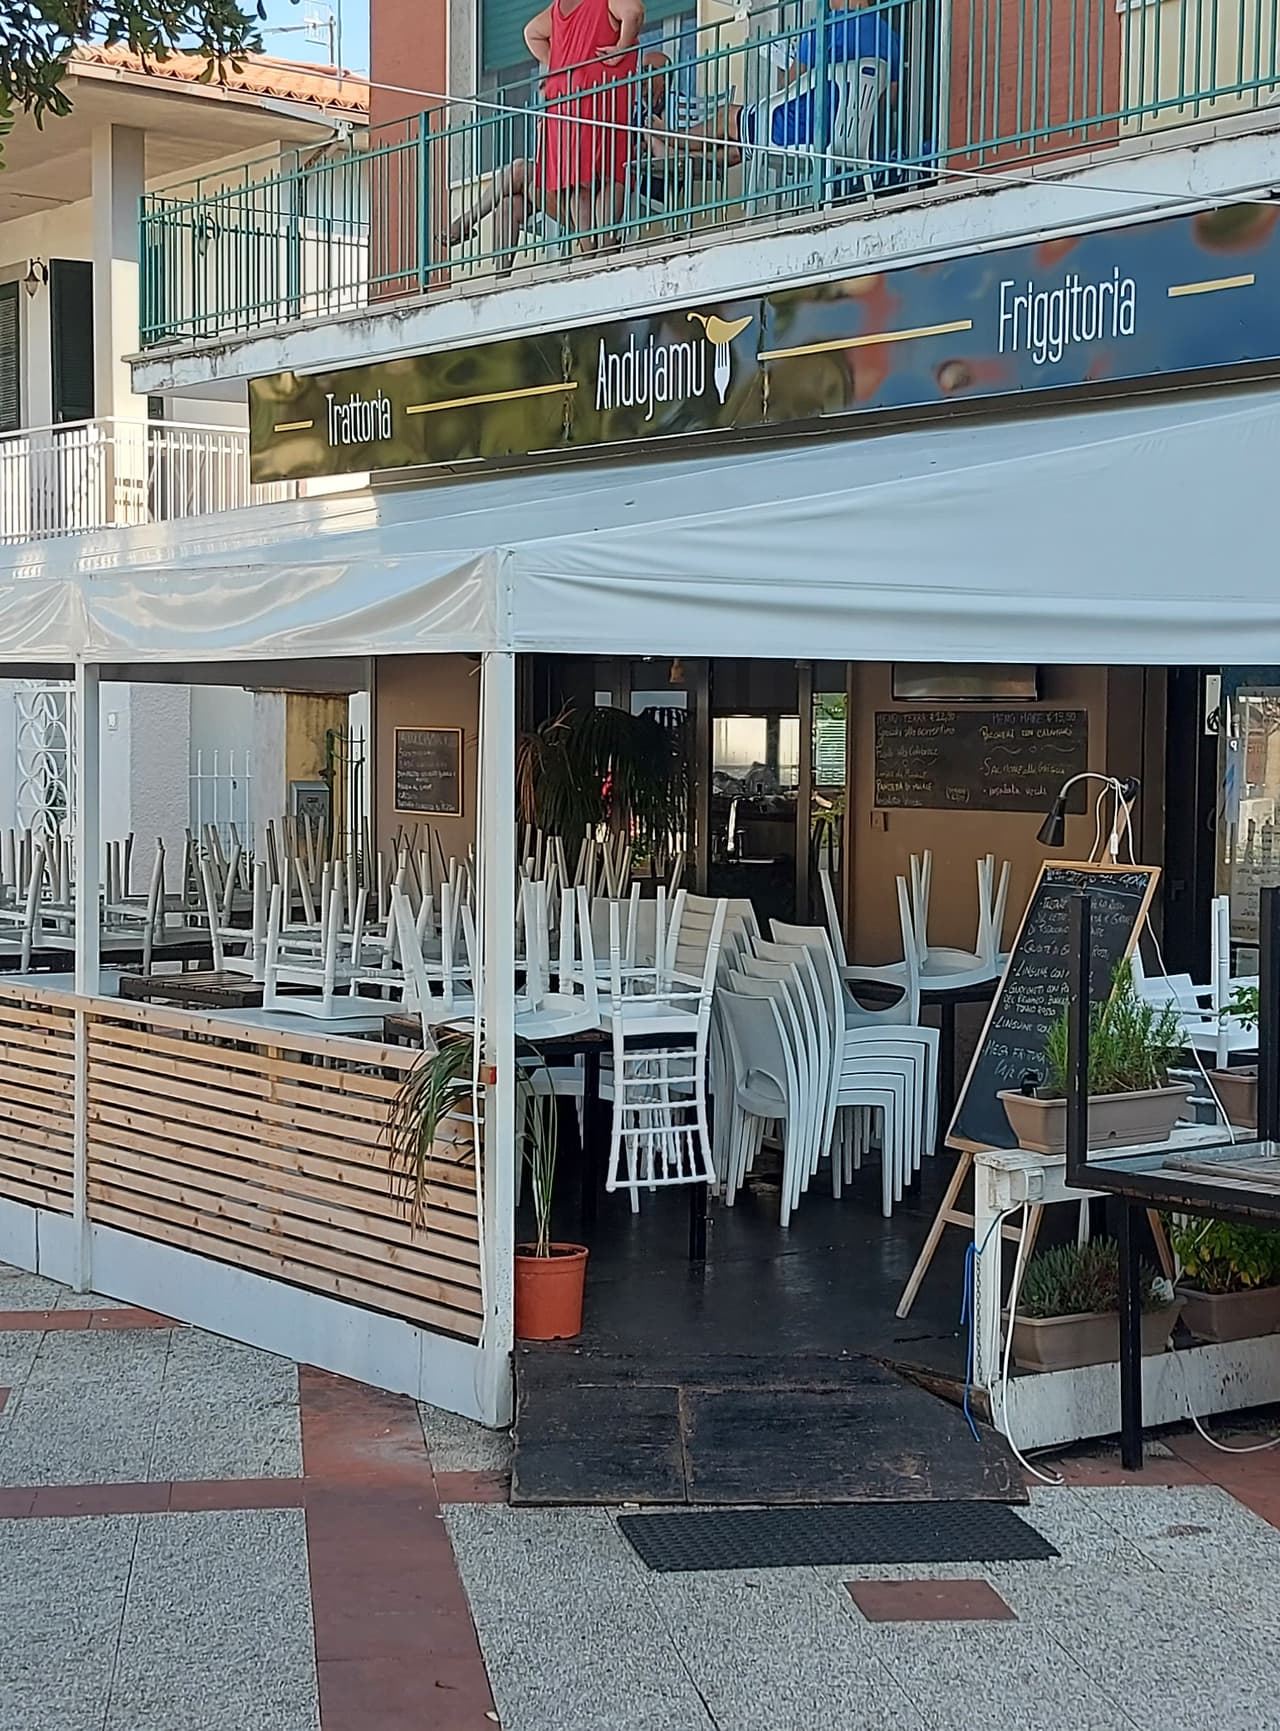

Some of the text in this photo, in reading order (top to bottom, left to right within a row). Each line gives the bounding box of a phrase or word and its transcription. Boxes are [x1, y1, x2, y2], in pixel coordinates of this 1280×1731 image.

[999, 266, 1135, 365] Friggitoria
[325, 388, 392, 447] Trattoria
[595, 333, 706, 421] Andujamu
